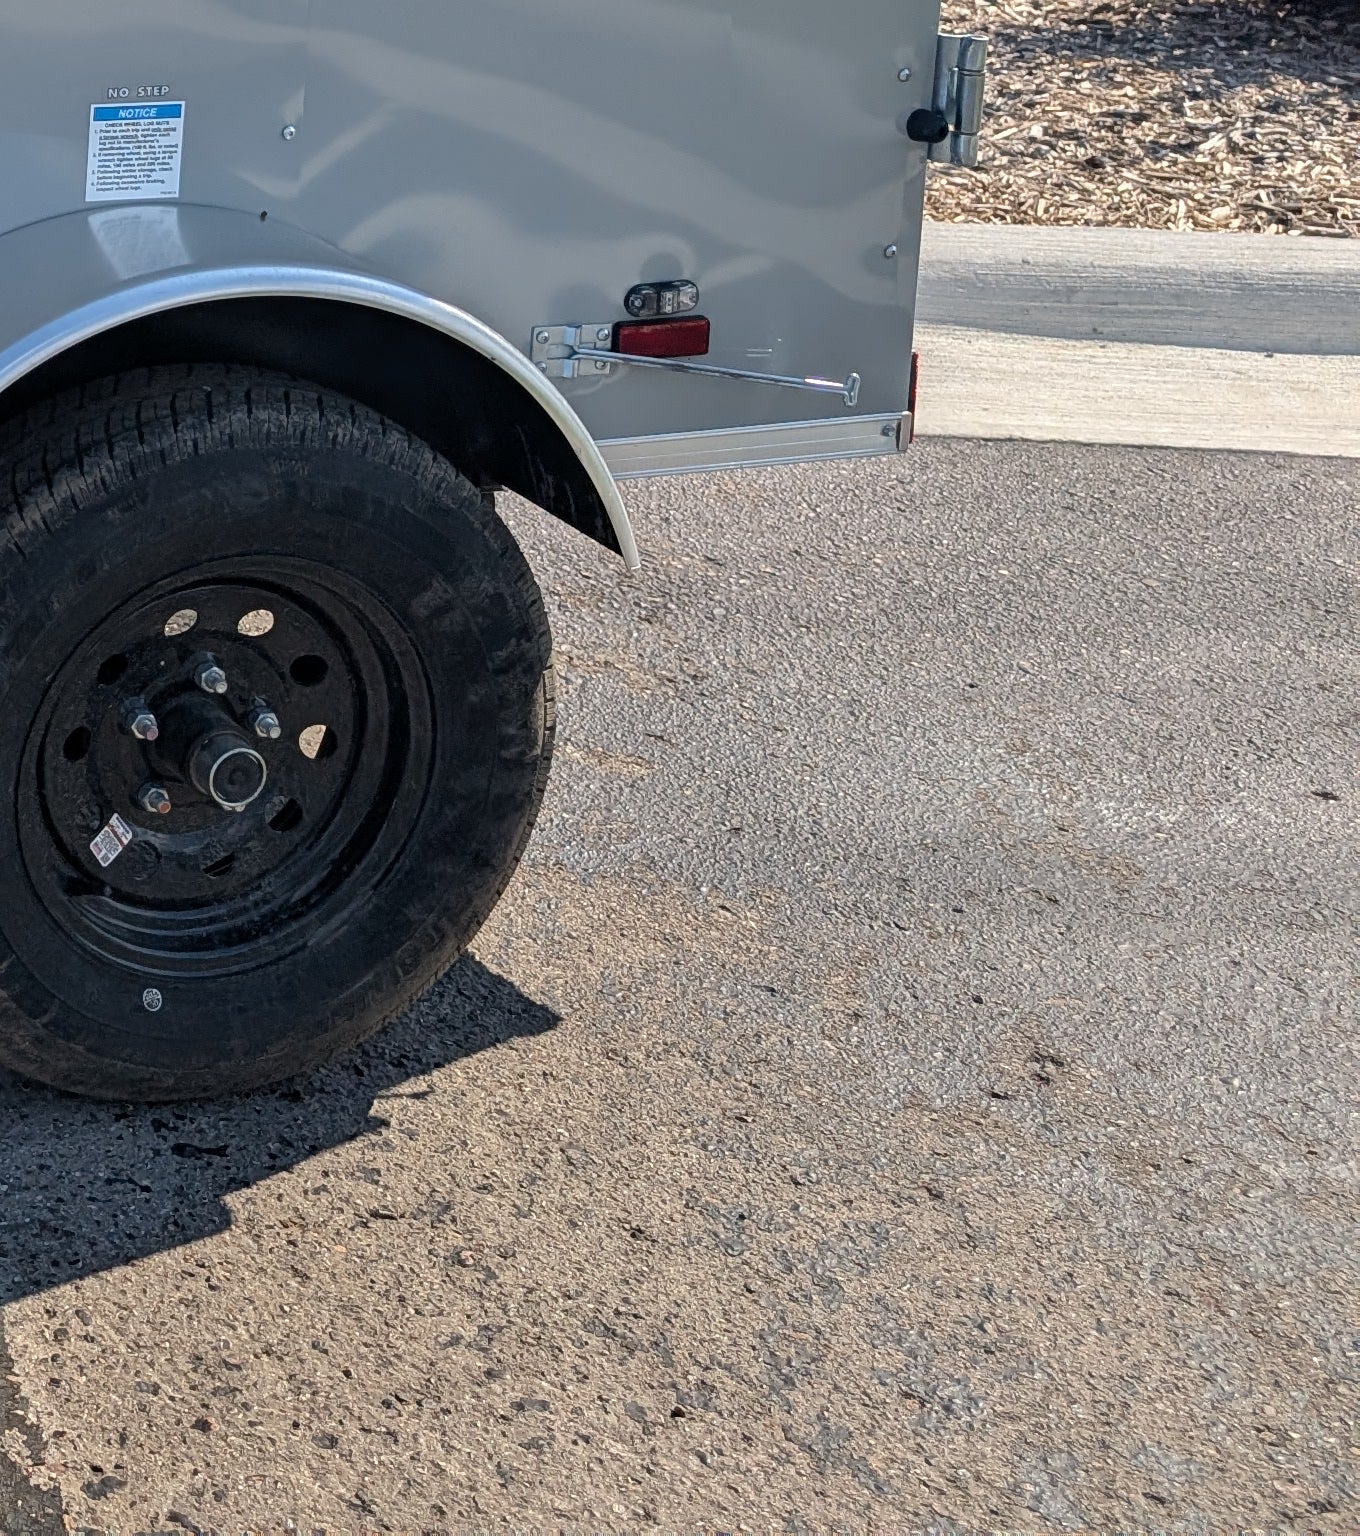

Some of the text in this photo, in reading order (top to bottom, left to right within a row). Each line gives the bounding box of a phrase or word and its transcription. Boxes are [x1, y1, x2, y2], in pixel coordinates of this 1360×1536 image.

[108, 86, 170, 98] NO STEP
[118, 108, 157, 118] NOTICE
